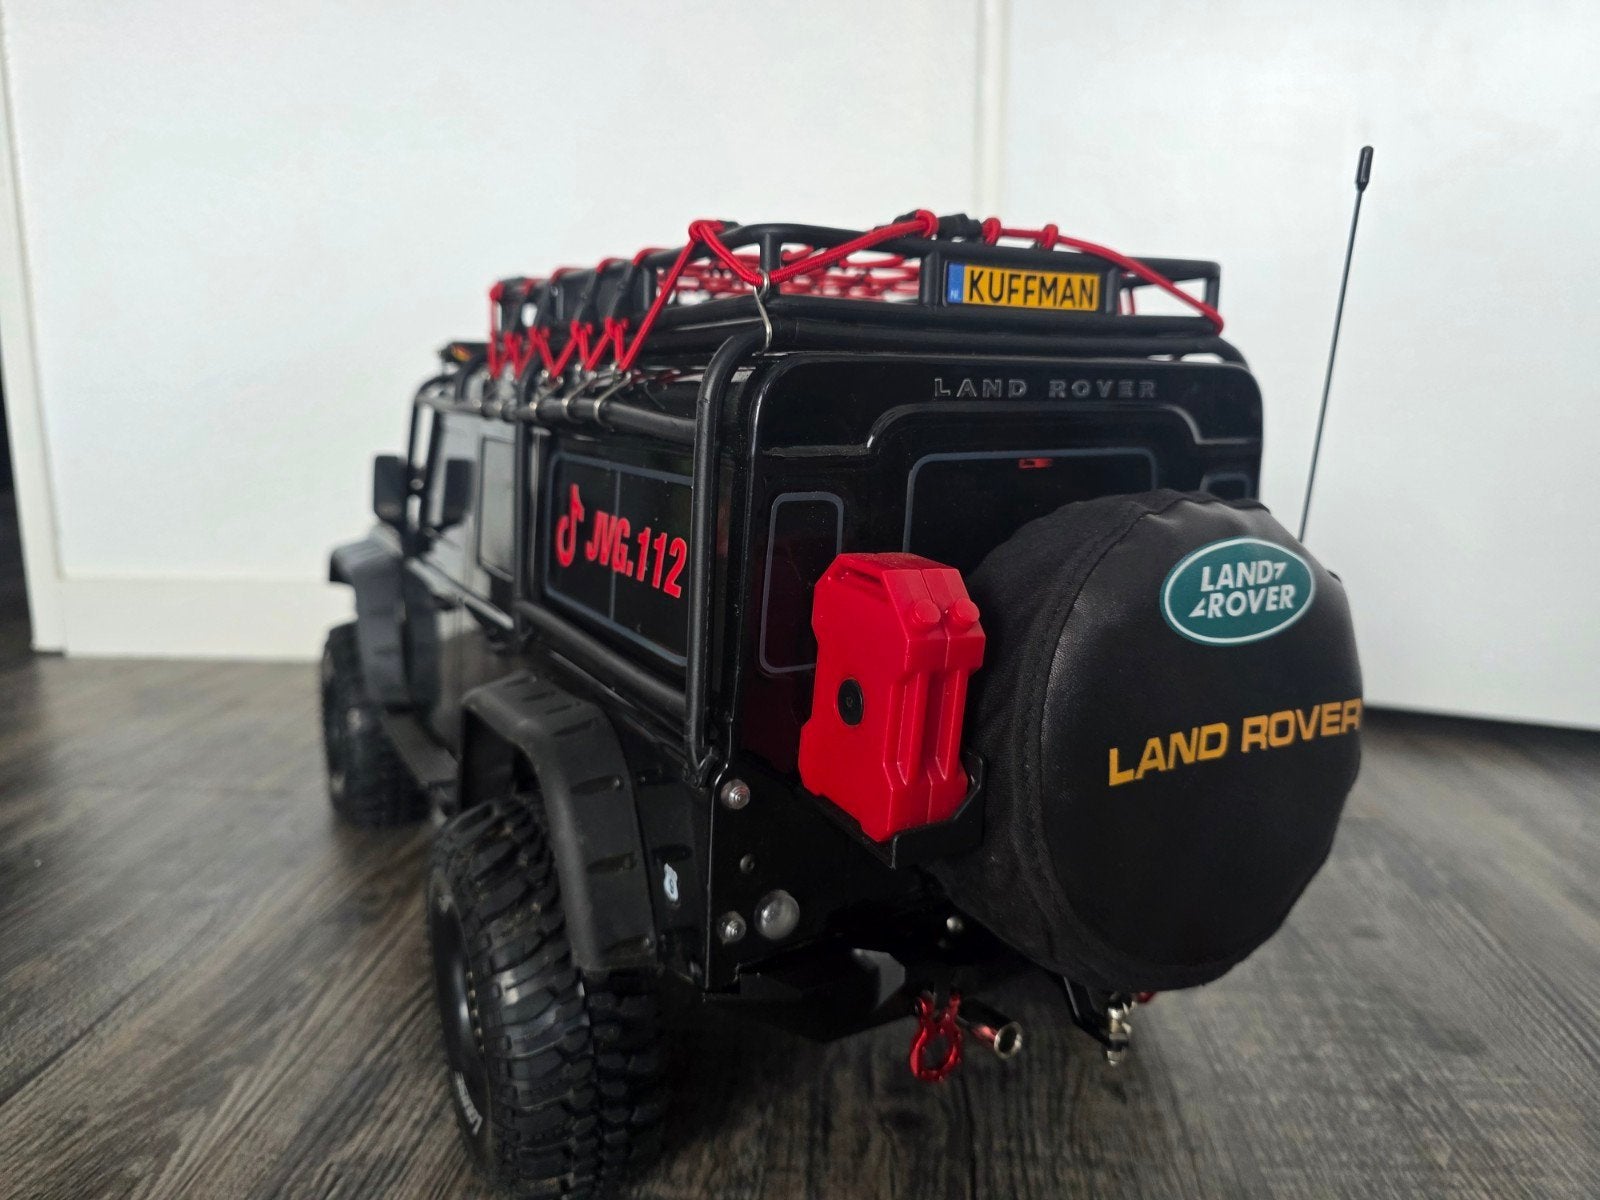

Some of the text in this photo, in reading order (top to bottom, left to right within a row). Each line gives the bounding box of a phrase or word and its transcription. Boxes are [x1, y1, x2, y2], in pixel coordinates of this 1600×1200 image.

[968, 269, 1096, 308] KUFFMAN
[934, 377, 1156, 398] LAND ROVER
[585, 510, 688, 599] JVG.112
[1200, 560, 1274, 592] LAND
[1207, 584, 1296, 618] ROVER
[1108, 698, 1361, 786] LAND ROVER
